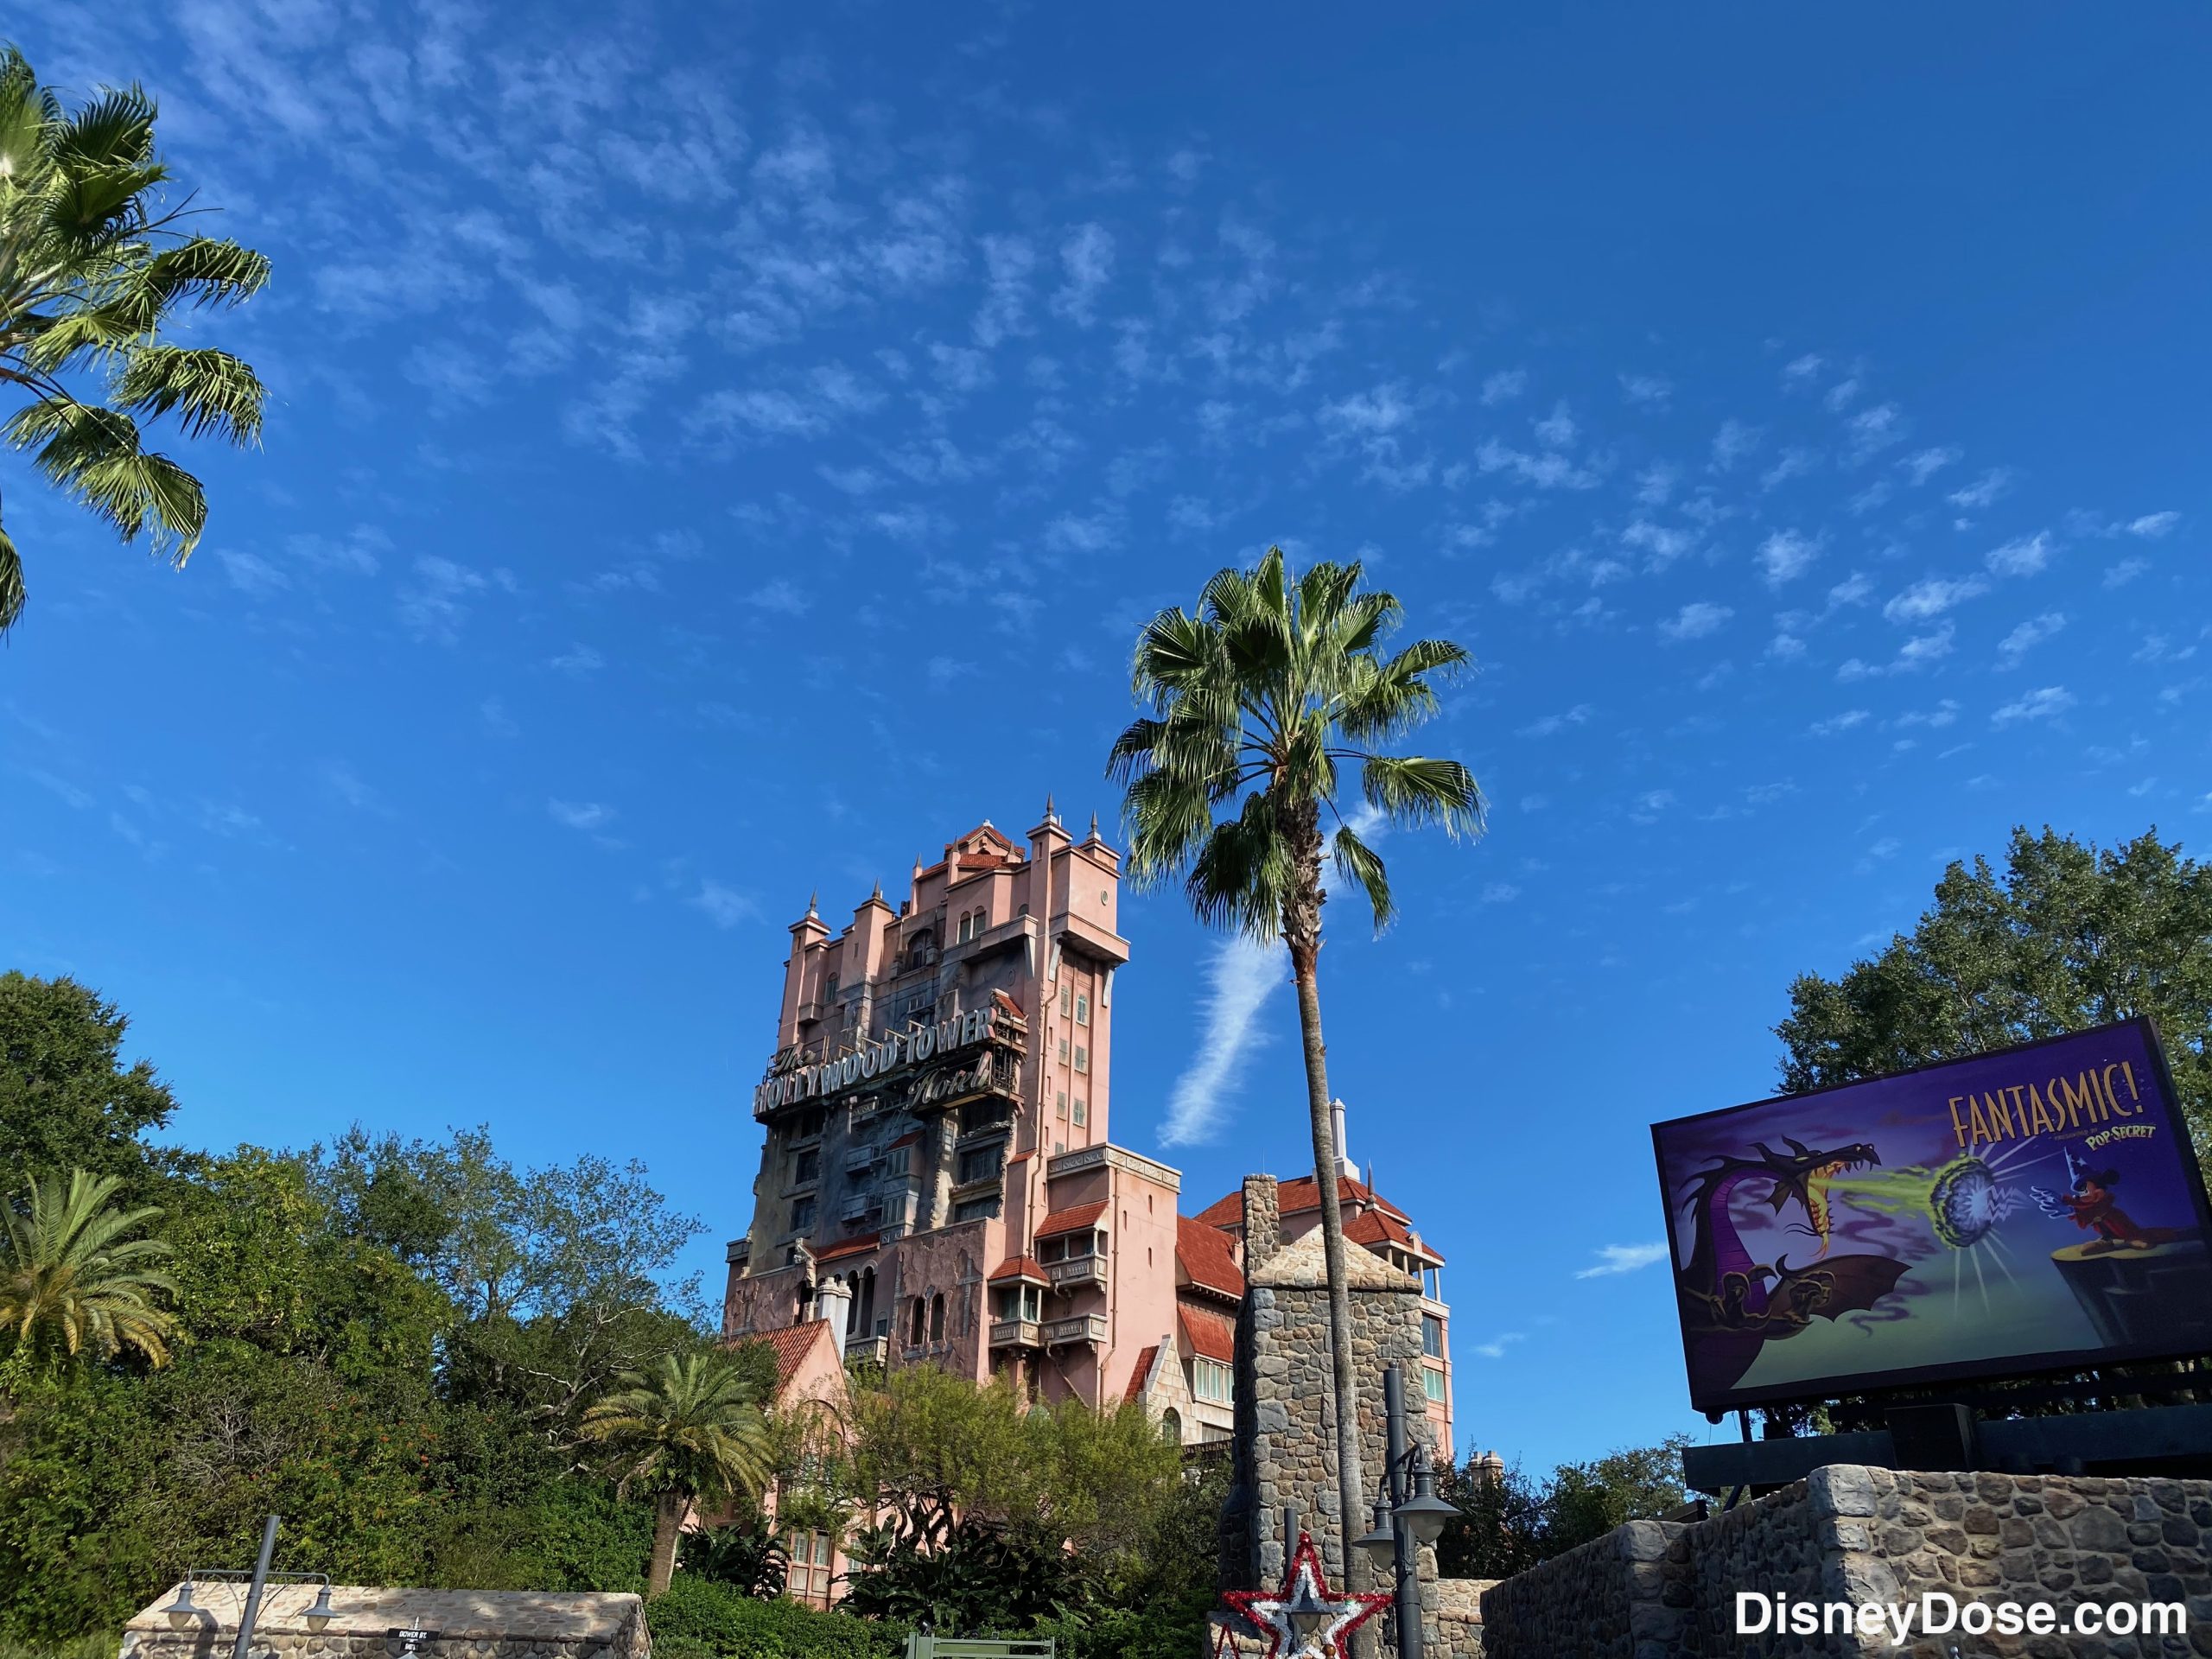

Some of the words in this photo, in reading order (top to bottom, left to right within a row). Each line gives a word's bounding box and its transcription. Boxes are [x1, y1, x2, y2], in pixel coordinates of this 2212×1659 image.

[753, 1041, 898, 1114] HOLLYWOOD
[906, 1007, 996, 1065] TOWER
[768, 1042, 815, 1077] The
[903, 1051, 993, 1110] Hotel
[1948, 1061, 2143, 1147] FANTASMIC!
